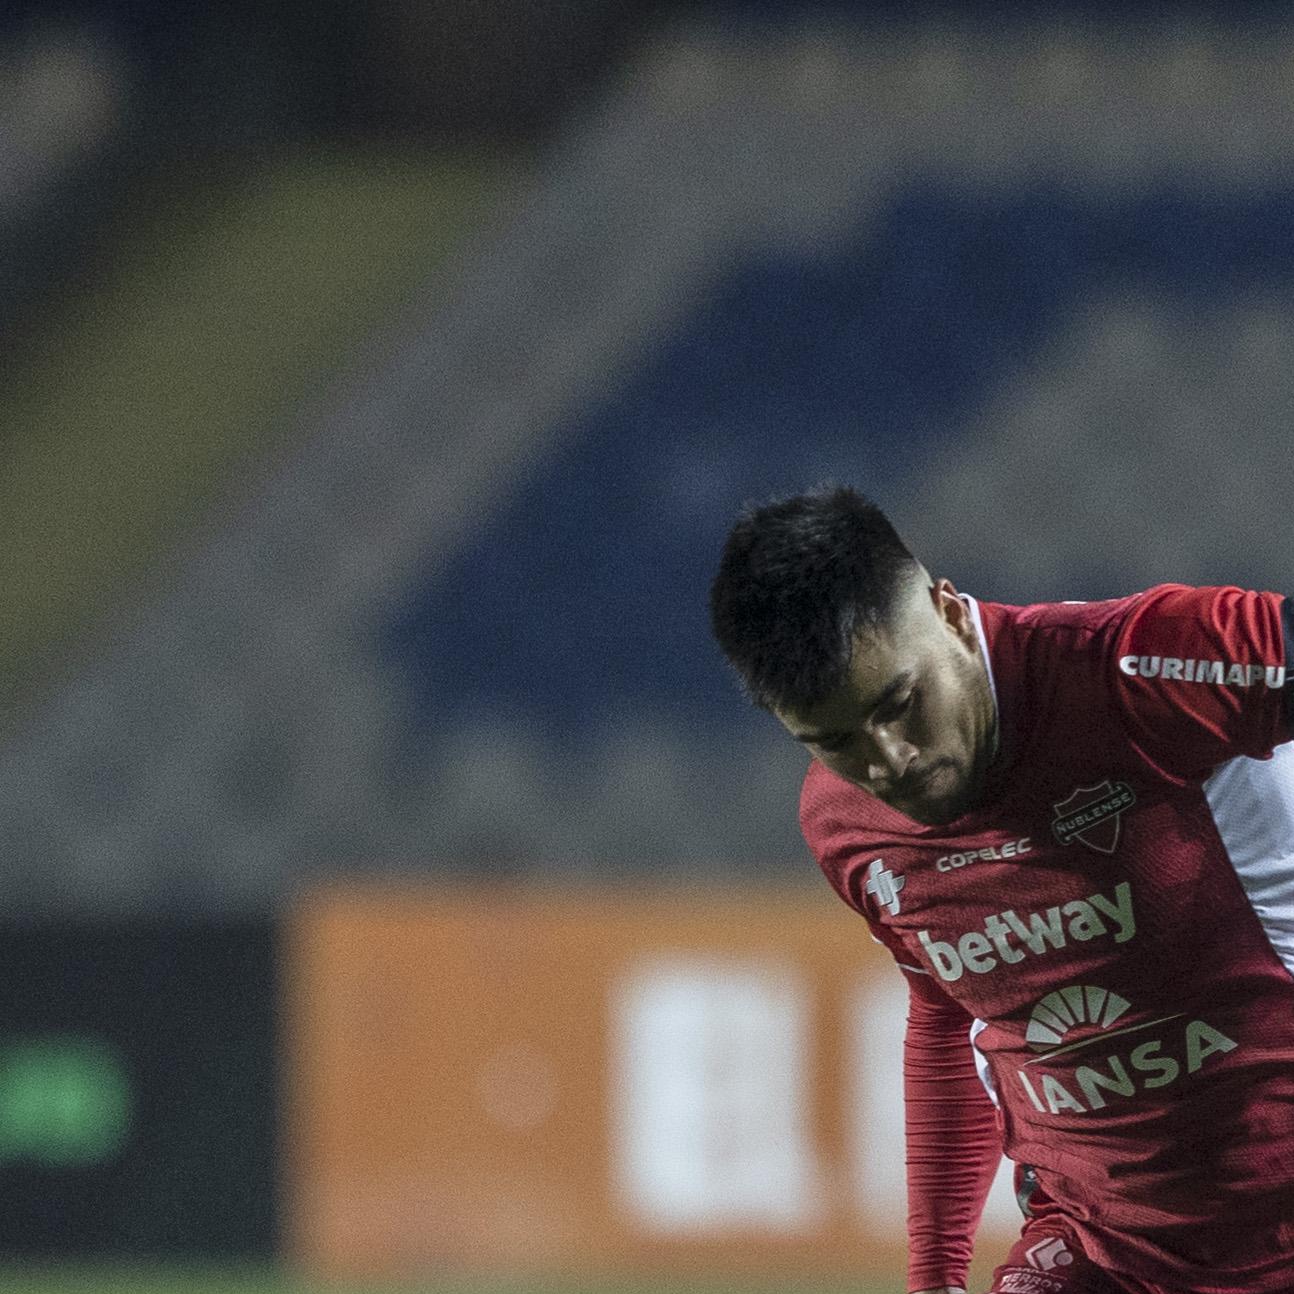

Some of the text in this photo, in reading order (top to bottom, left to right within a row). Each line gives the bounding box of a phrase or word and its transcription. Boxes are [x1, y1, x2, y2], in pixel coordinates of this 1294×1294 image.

[935, 837, 1032, 873] COPELEC
[917, 881, 1137, 982] betway
[1018, 1020, 1239, 1114] IANSA
